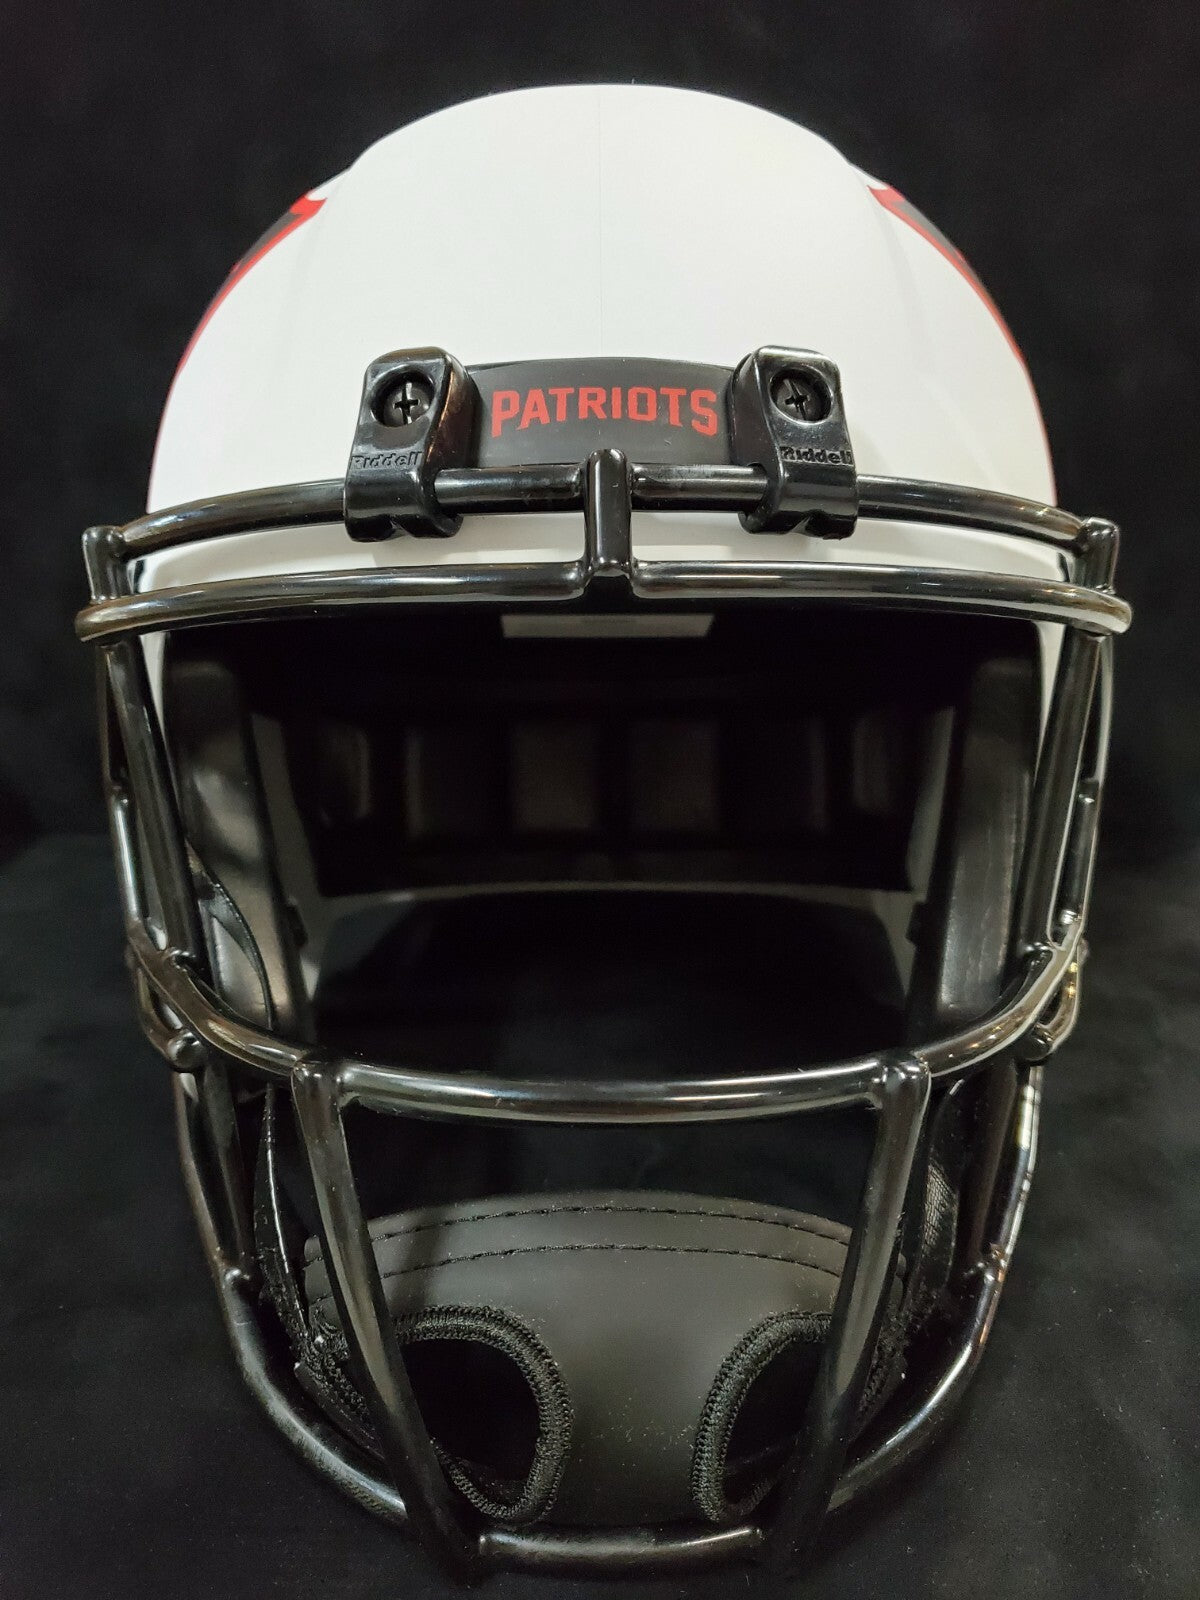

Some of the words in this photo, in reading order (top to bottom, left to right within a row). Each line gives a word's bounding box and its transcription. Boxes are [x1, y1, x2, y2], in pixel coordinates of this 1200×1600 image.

[491, 386, 718, 438] PATRIOTS
[350, 451, 423, 469] Riddell
[780, 446, 852, 465] Riddell
